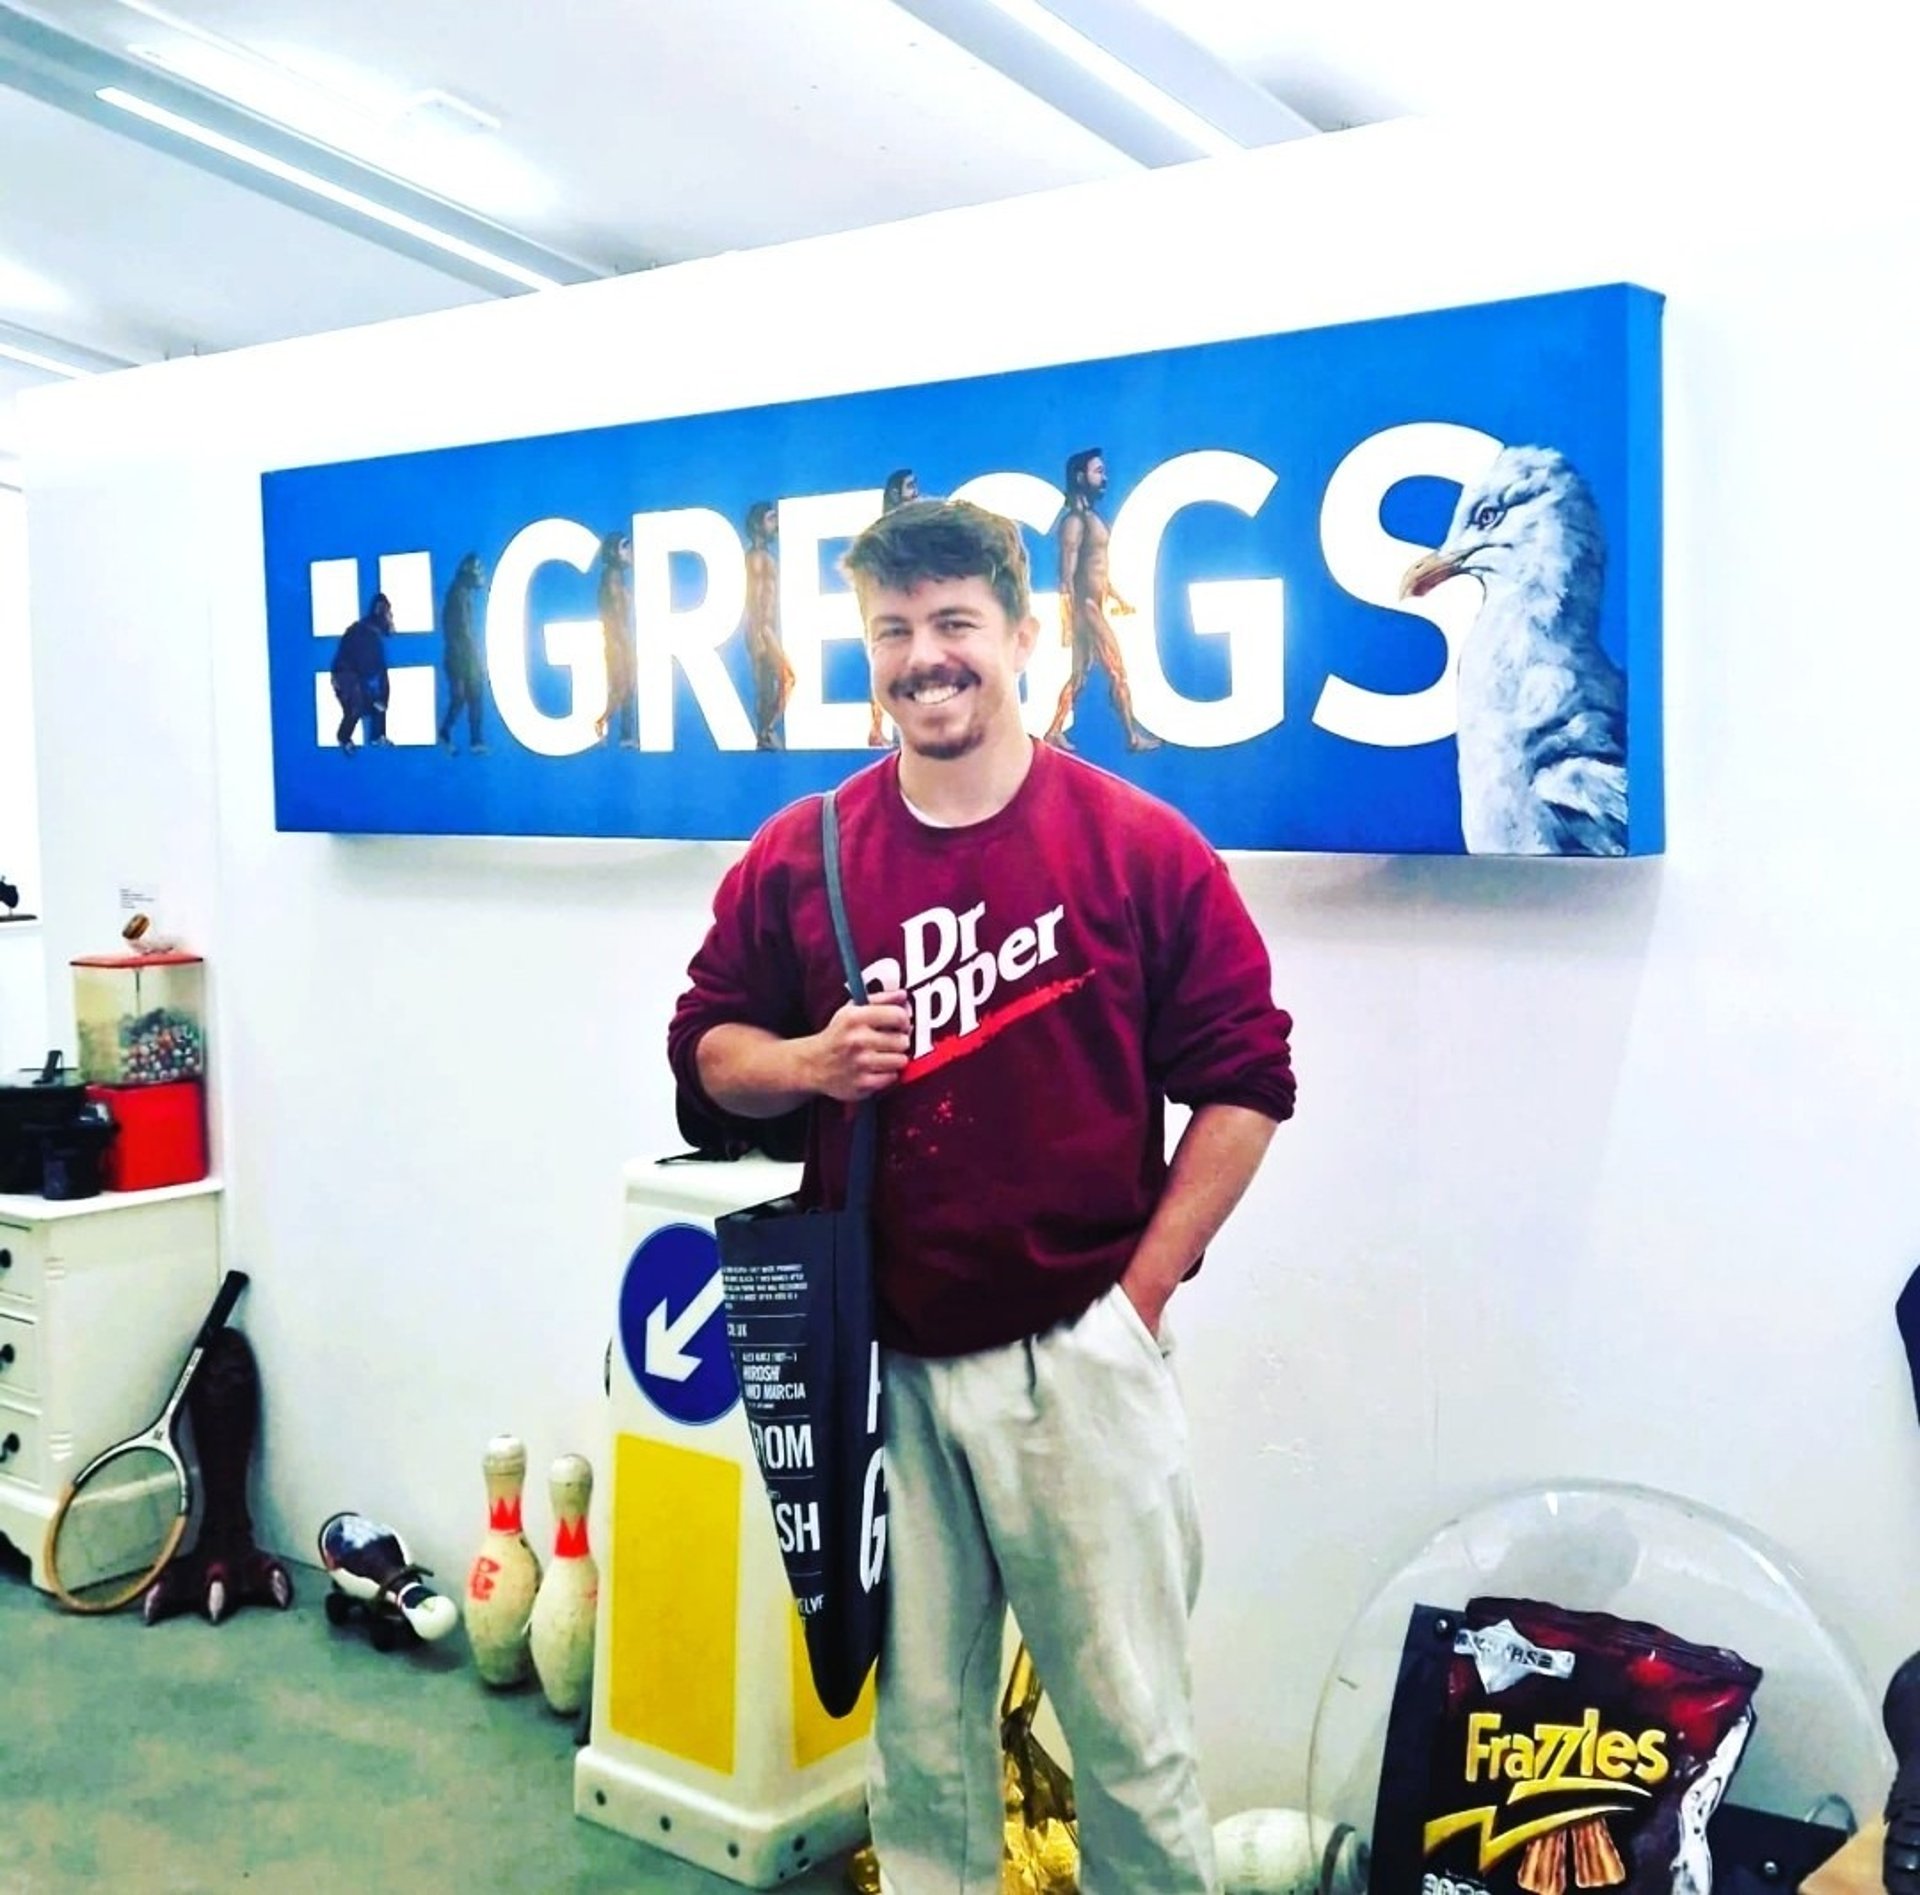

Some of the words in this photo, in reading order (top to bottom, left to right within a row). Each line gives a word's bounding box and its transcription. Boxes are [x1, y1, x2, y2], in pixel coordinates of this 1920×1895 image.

[845, 904, 1064, 1060] pper
[901, 901, 986, 989] Dr
[763, 1382, 807, 1401] MARCIA
[1464, 1708, 1670, 1784] Frazzles
